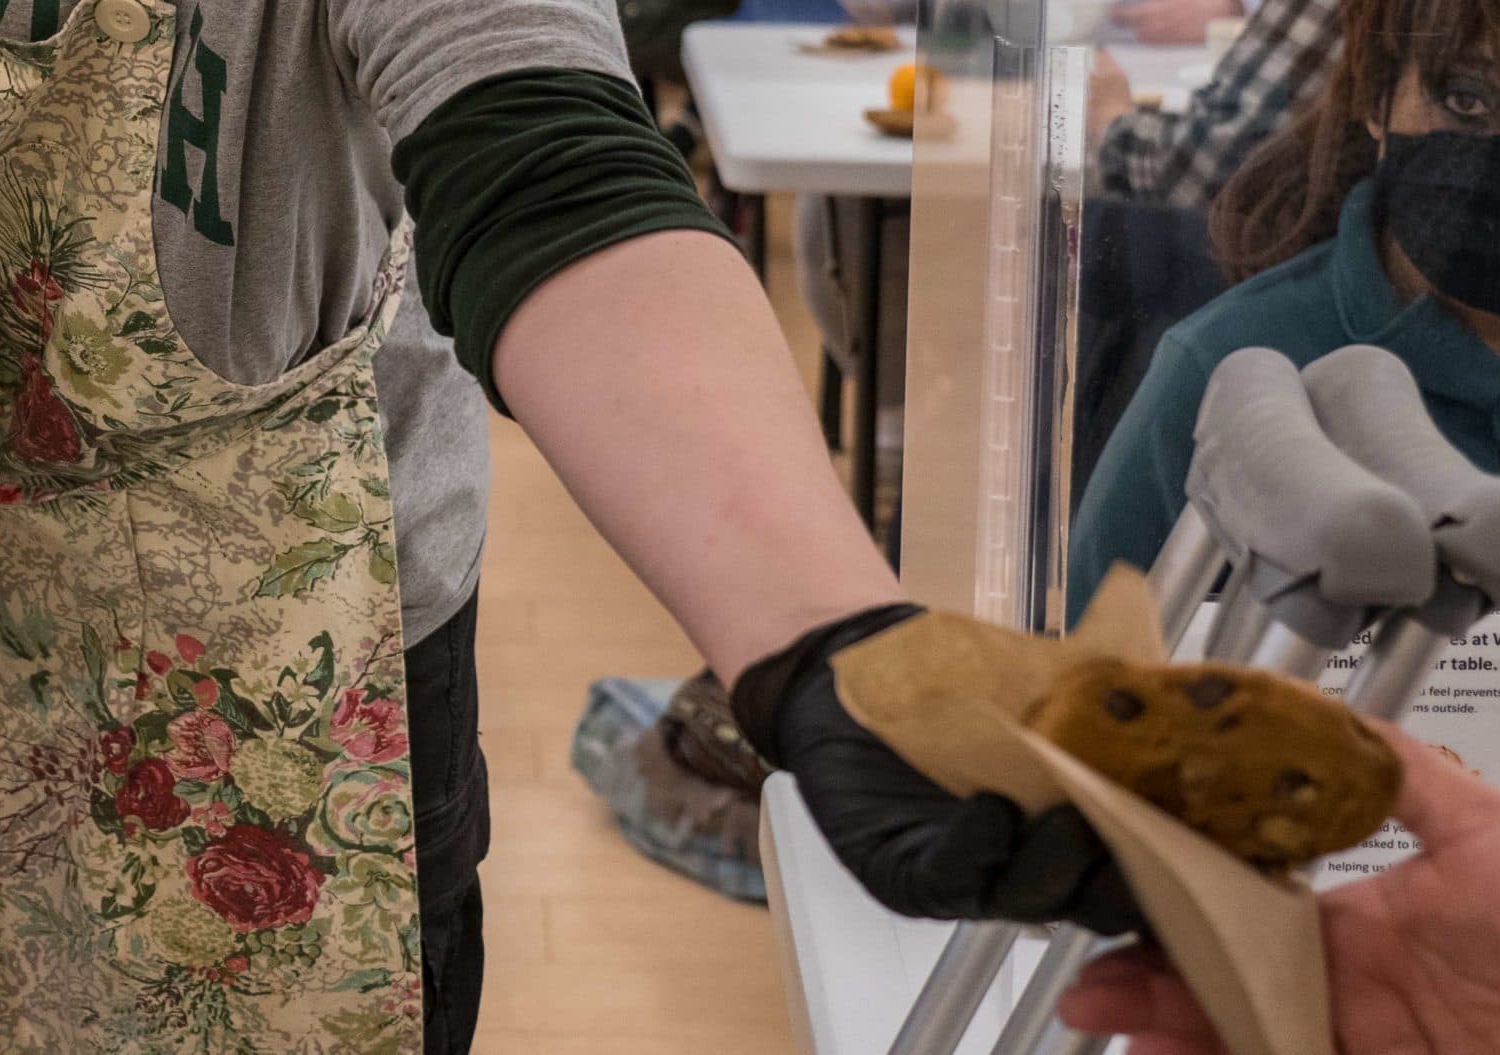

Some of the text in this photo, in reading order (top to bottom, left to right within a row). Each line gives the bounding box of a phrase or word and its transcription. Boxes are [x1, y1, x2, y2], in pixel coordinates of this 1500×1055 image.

[1471, 633, 1489, 646] at
[1326, 655, 1364, 669] rink
[1451, 657, 1498, 672] table.
[1429, 686, 1451, 697] feel
[1432, 703, 1477, 714] outside.
[1362, 839, 1395, 849] asked
[1398, 840, 1410, 849] to
[1328, 862, 1369, 874] helping
